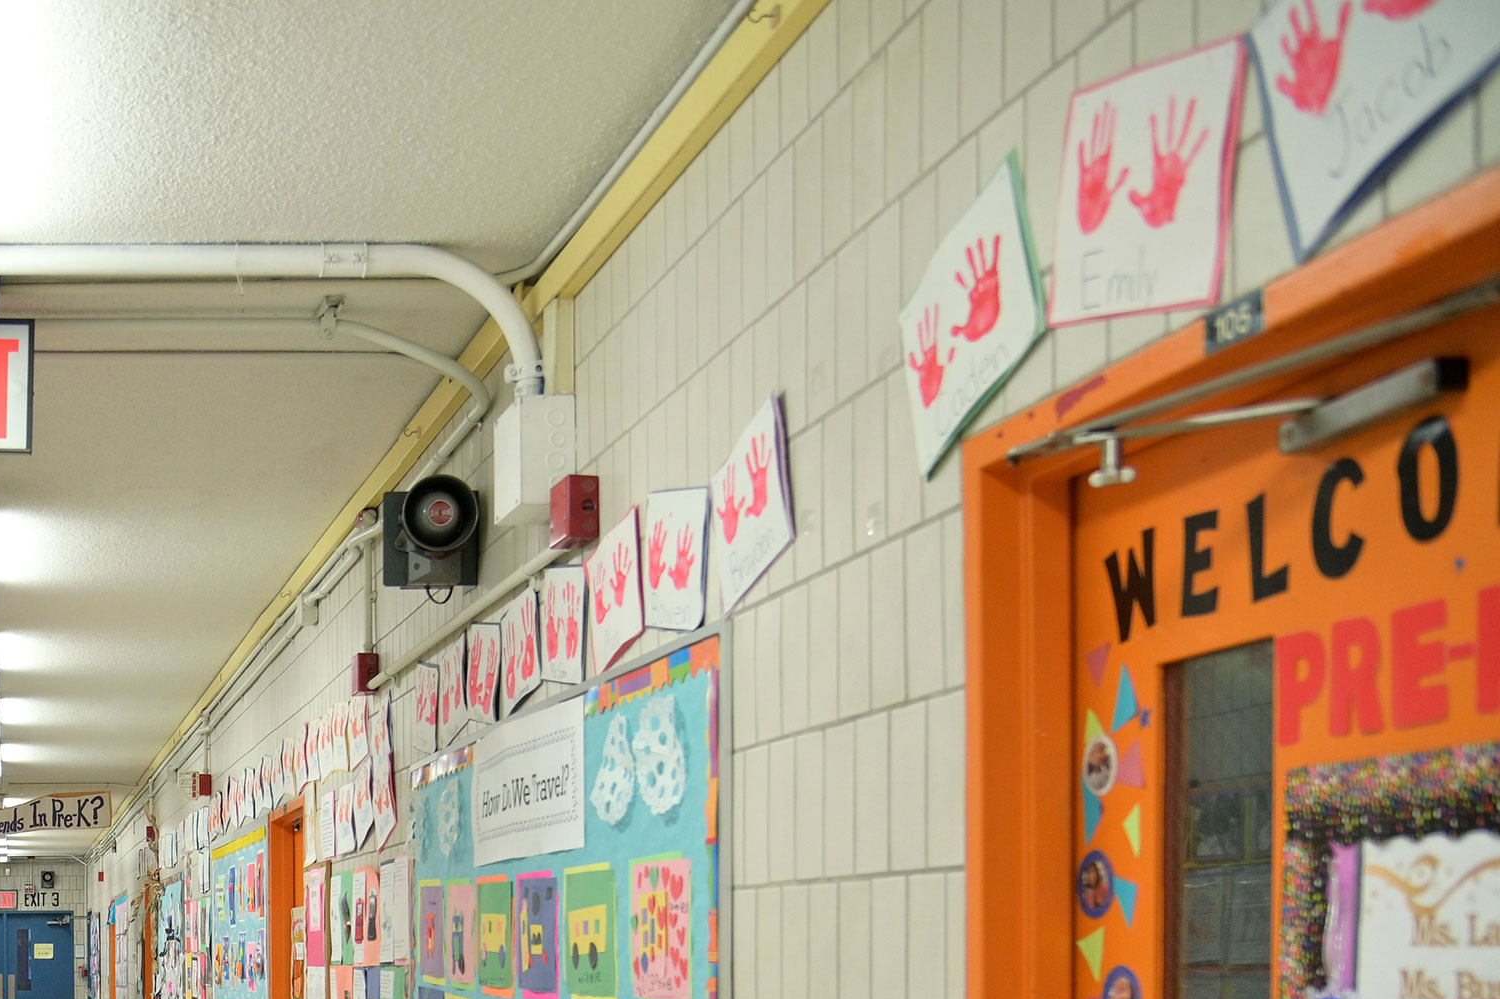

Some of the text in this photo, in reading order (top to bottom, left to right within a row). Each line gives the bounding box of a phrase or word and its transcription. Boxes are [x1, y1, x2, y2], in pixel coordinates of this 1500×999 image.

[1326, 22, 1452, 180] Jacob
[1079, 246, 1160, 312] Emily
[1104, 415, 1500, 643] WELCO
[29, 800, 48, 828] In
[52, 796, 105, 828] Pre-K?
[482, 789, 501, 819] How
[511, 776, 531, 806] We
[531, 763, 570, 803] Travel?
[24, 892, 59, 907] EXIT 3
[1412, 912, 1457, 948] Ms.
